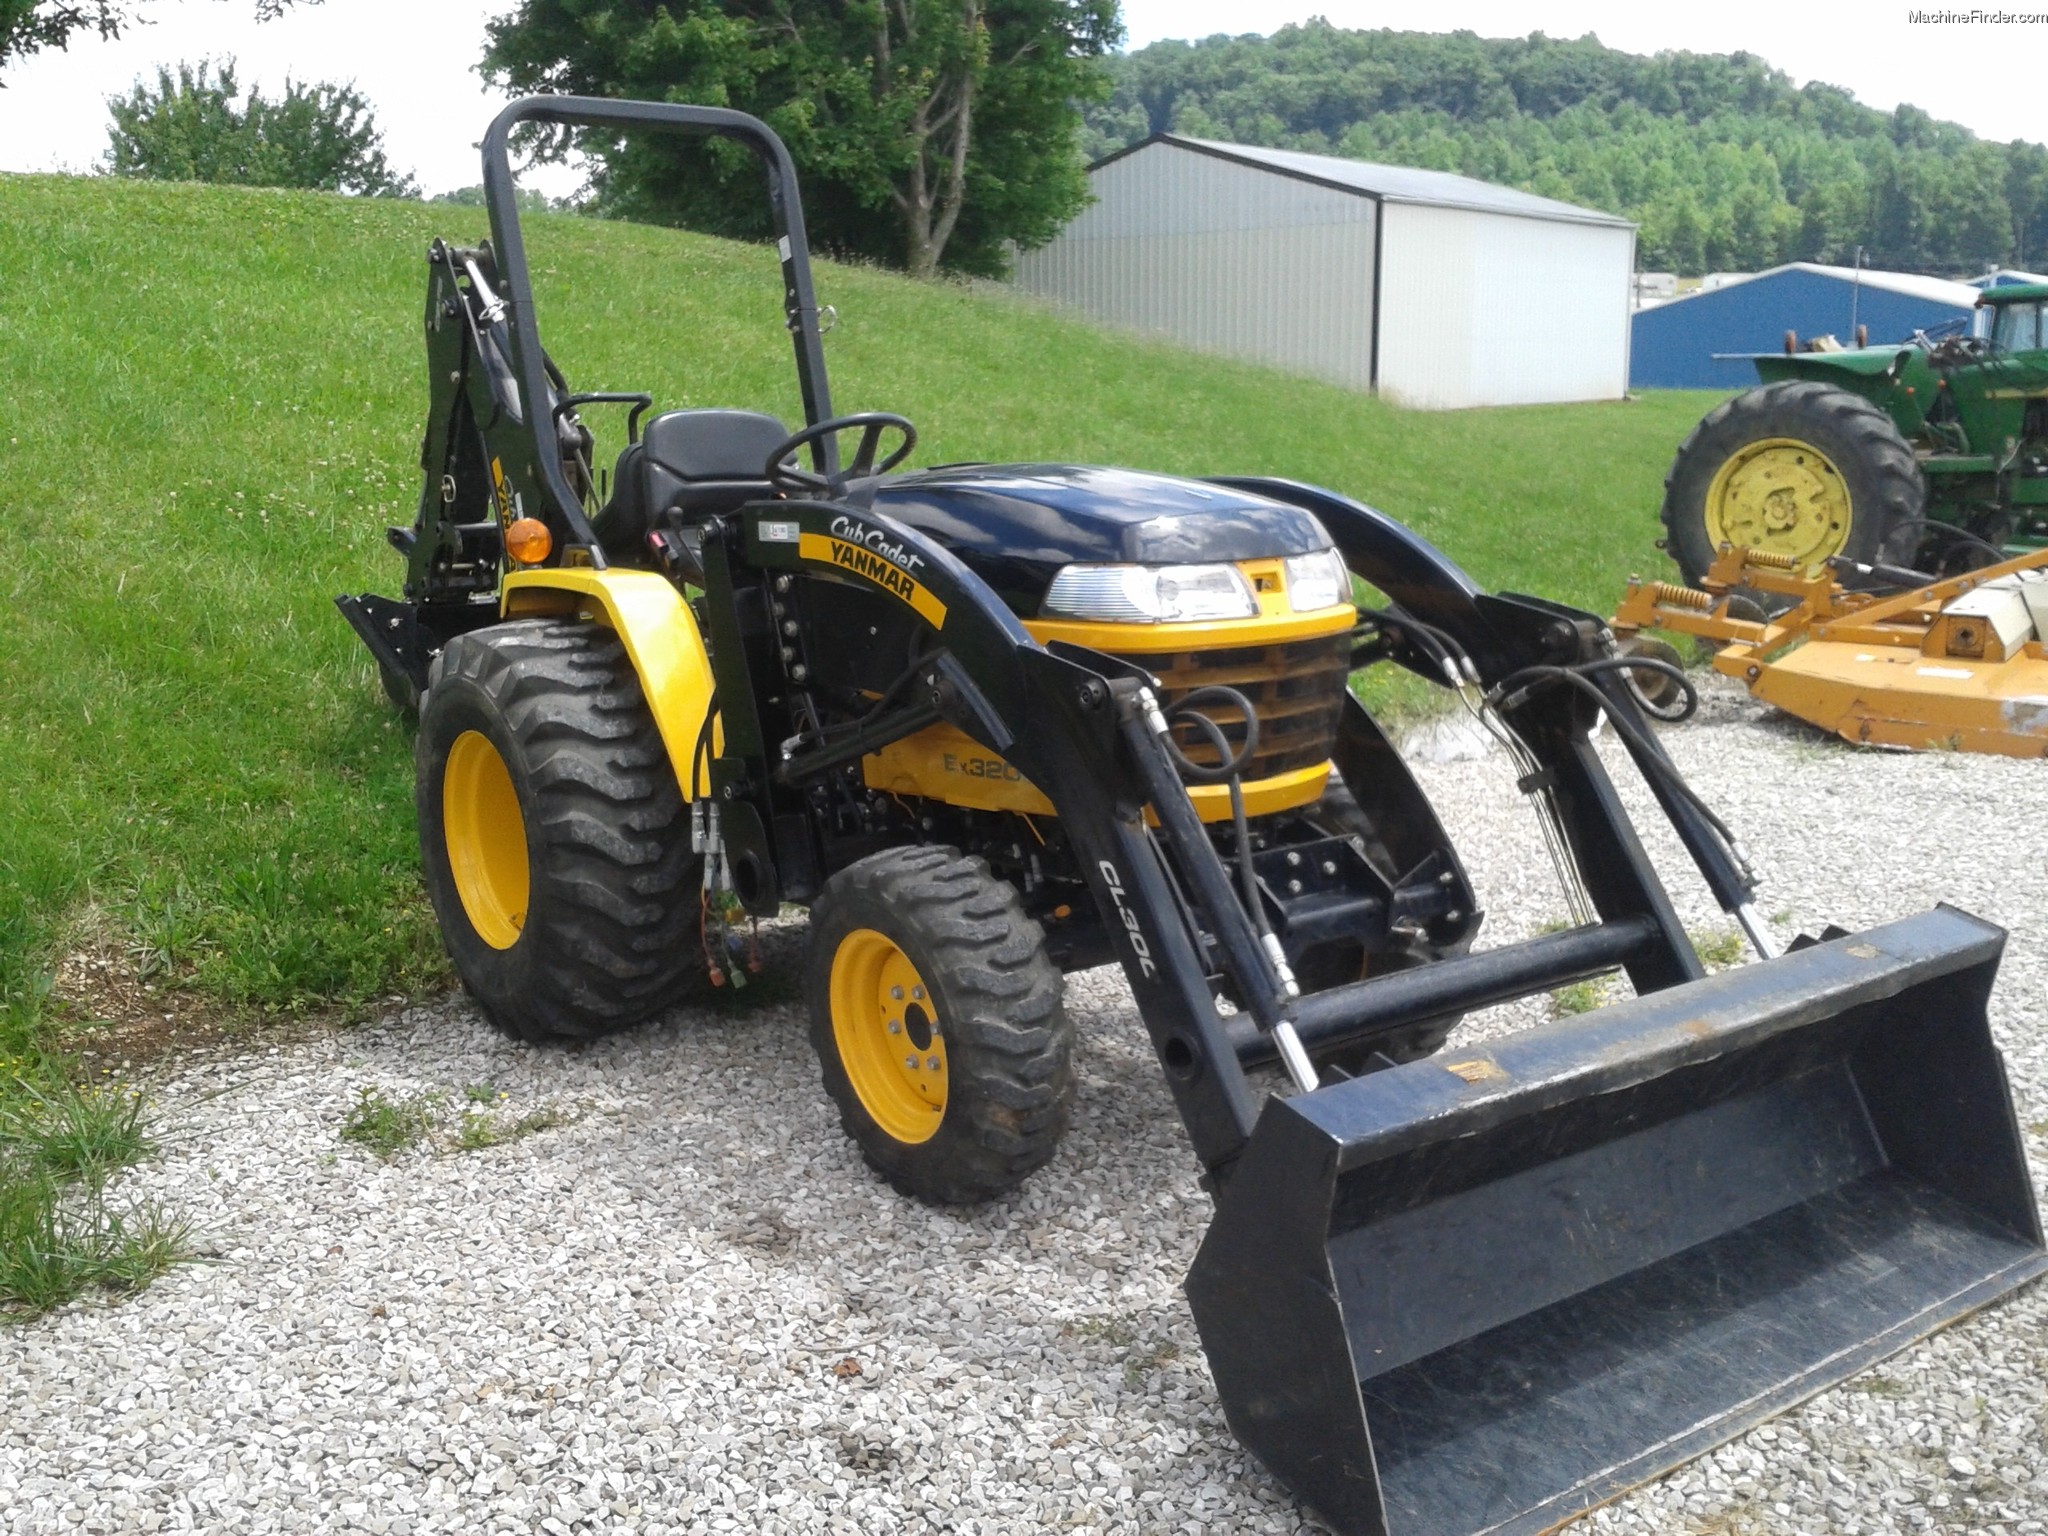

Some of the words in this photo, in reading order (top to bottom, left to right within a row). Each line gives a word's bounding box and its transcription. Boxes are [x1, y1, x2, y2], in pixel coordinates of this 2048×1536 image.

[830, 516, 864, 545] Cub
[864, 530, 925, 576] Cadet
[830, 541, 915, 602] YANMAR
